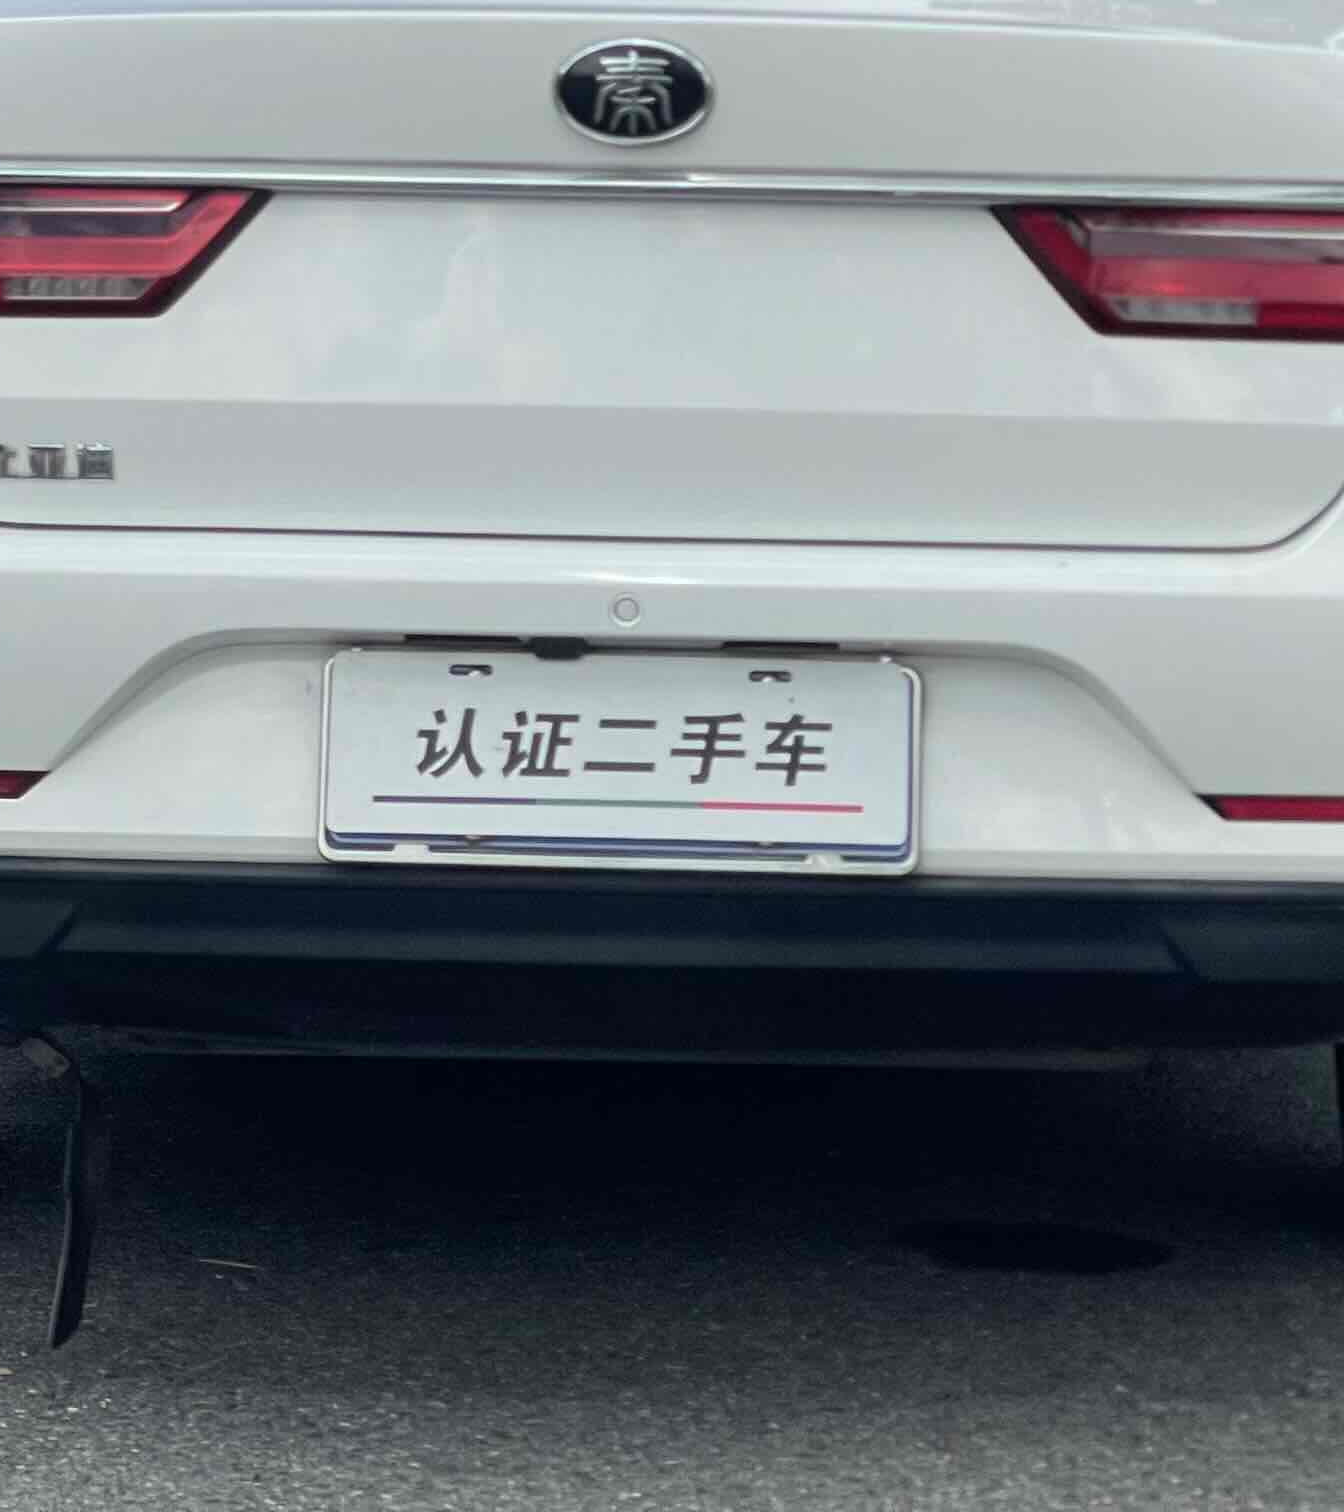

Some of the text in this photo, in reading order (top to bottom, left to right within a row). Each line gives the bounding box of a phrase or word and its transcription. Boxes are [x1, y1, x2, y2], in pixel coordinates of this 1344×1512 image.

[415, 707, 833, 787] 认证二手车
